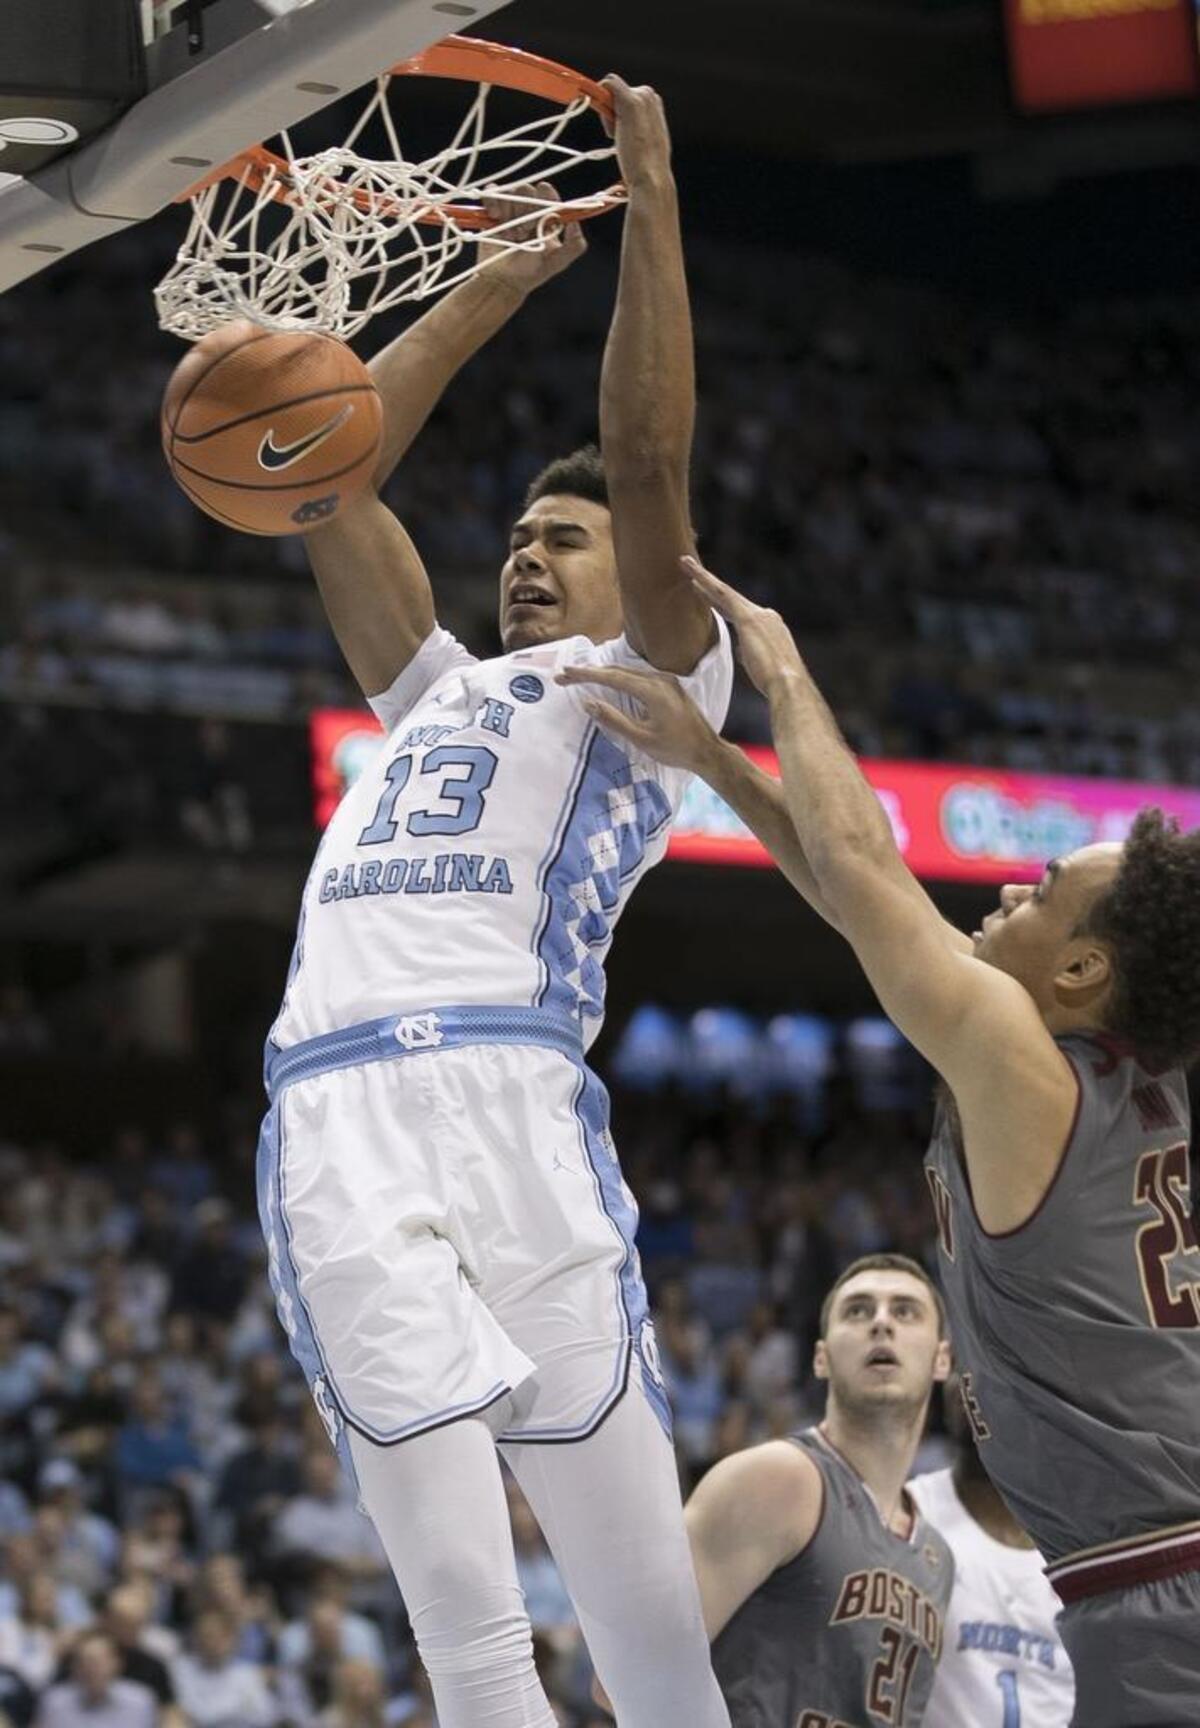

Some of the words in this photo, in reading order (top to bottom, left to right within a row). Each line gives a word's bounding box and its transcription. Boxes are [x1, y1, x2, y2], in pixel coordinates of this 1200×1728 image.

[357, 745, 499, 847] 13
[318, 853, 514, 904] CAROLINA
[828, 1567, 945, 1664] BOSTO
[957, 1620, 1055, 1671] NORTH
[865, 1623, 920, 1728] 21
[996, 1669, 1021, 1728] 1
